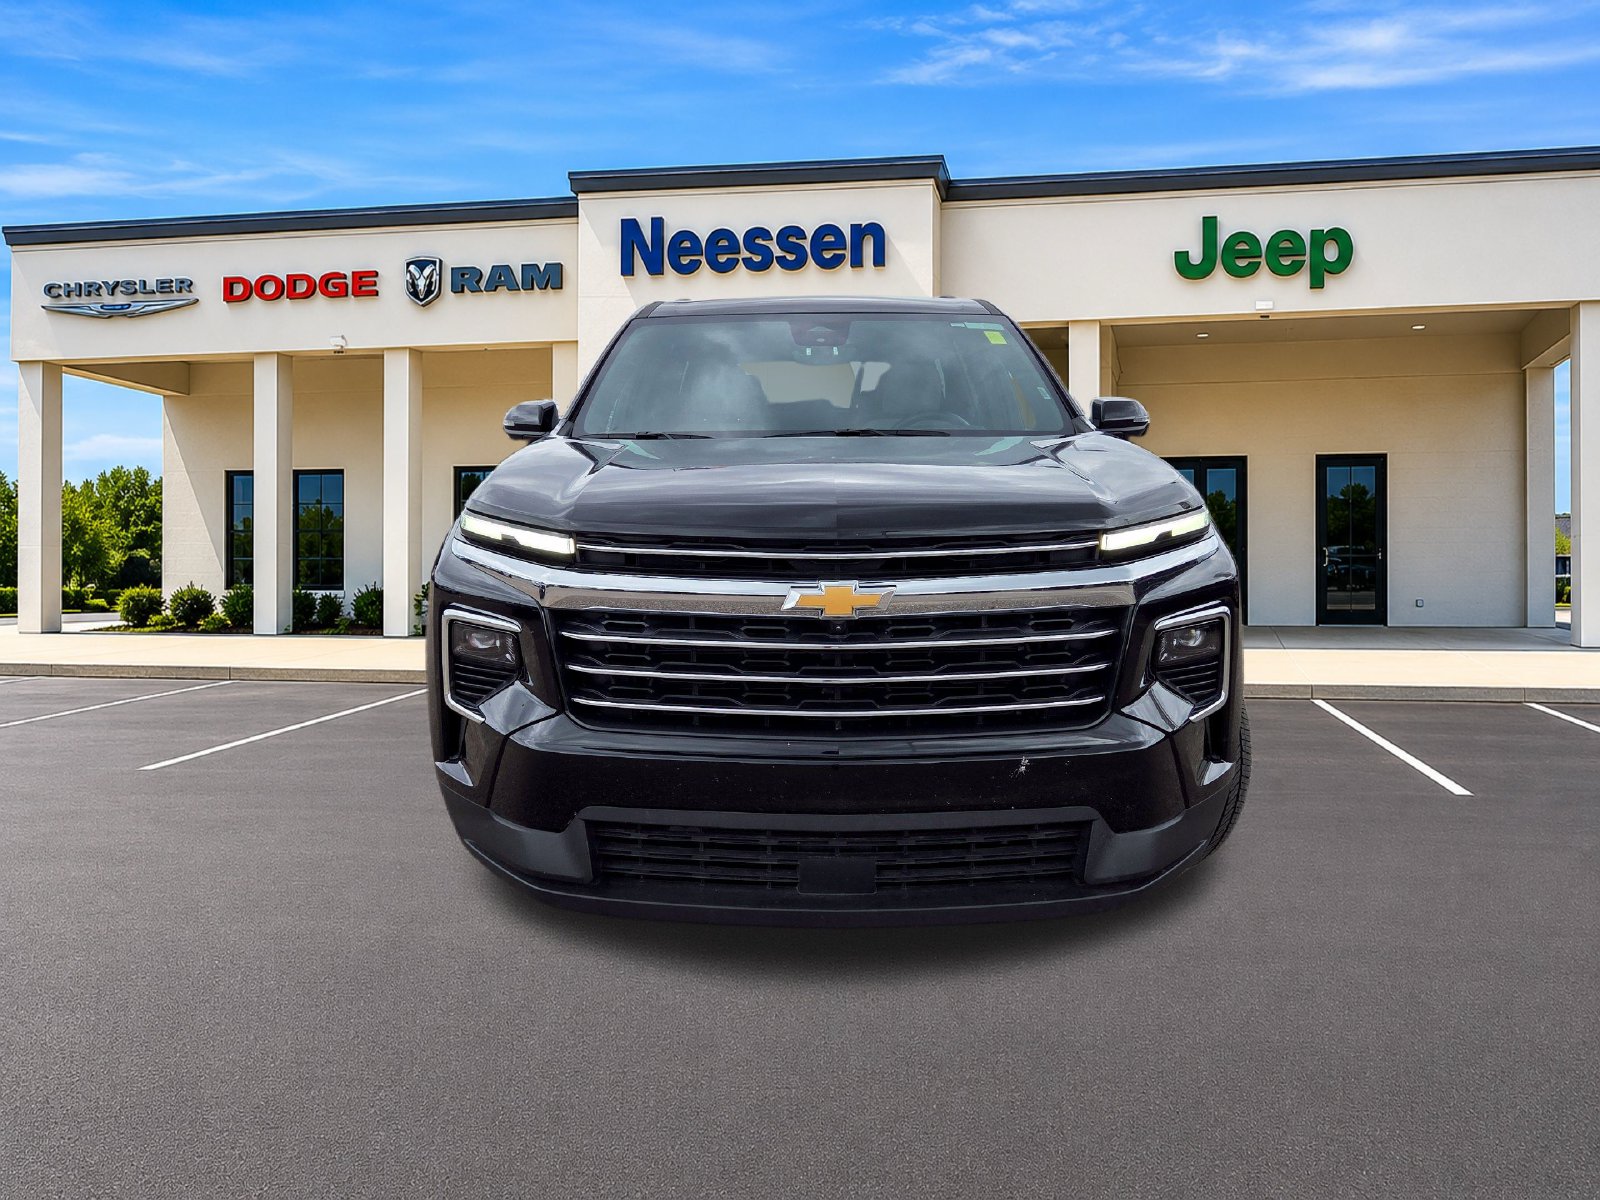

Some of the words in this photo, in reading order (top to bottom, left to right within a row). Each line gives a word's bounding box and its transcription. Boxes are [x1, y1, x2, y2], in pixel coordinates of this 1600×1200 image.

[621, 216, 886, 276] Neessen
[1174, 216, 1354, 288] Jeep
[43, 278, 193, 299] CHRYSLER
[223, 270, 379, 303] DODGE
[450, 262, 563, 293] RAM
